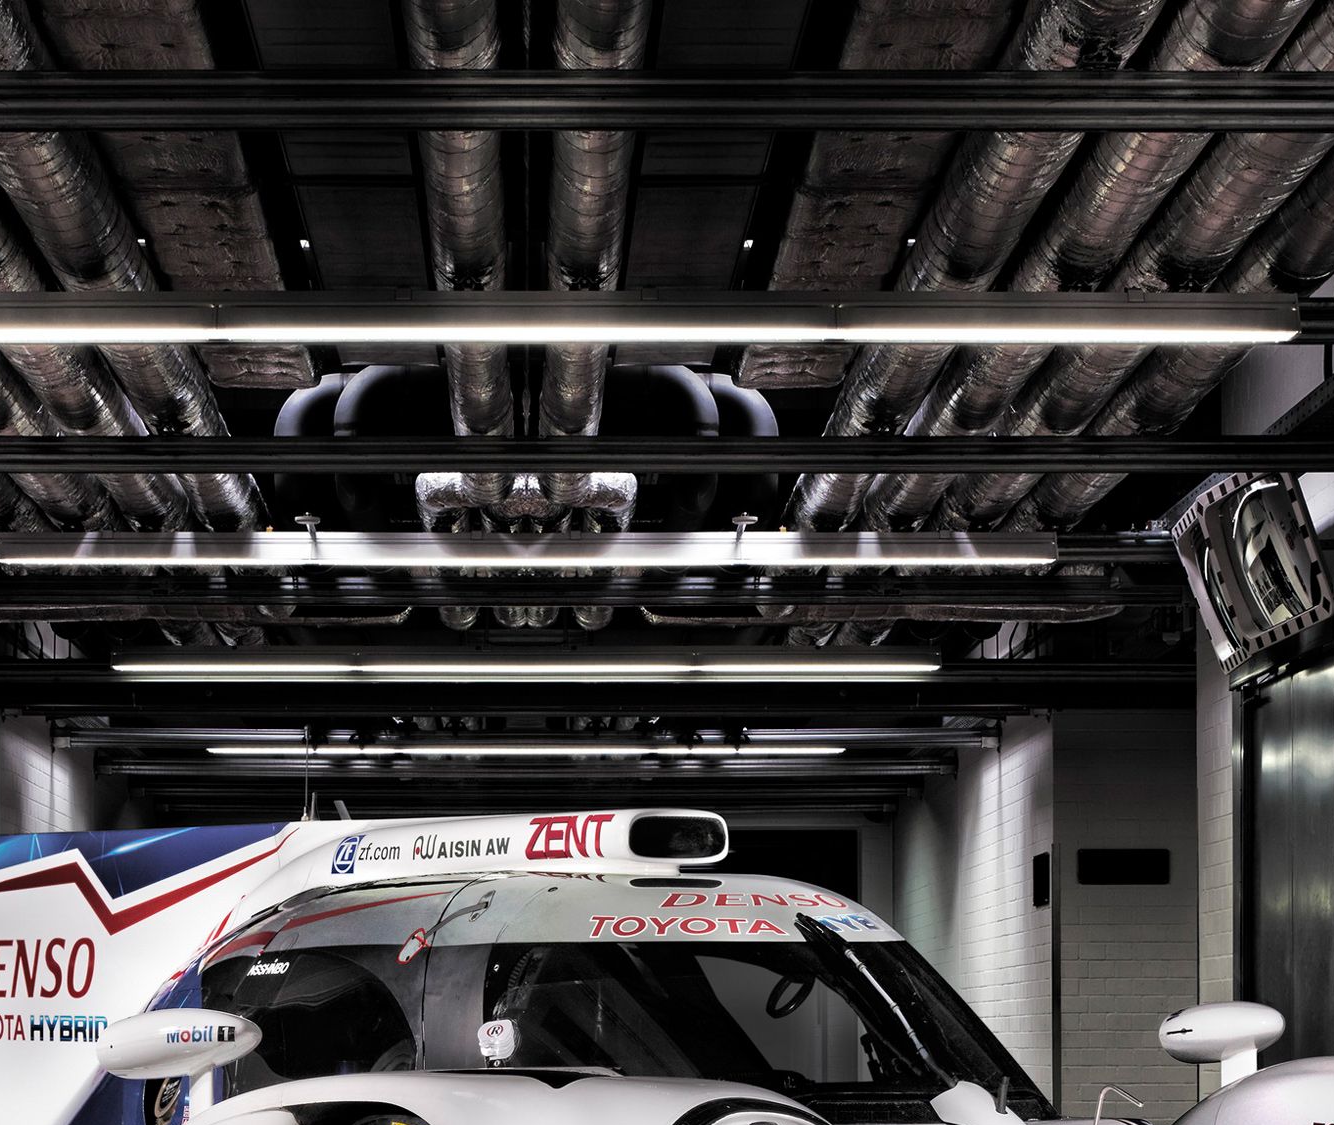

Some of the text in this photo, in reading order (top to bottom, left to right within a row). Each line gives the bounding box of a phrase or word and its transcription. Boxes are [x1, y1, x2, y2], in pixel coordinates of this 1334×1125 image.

[525, 814, 615, 860] ZENT
[359, 843, 400, 860] zf.com
[437, 840, 481, 858] AISIN
[485, 837, 510, 857] AW
[659, 892, 849, 909] DENSO
[590, 916, 789, 938] TOYOTA
[167, 1025, 213, 1043] Mobil
